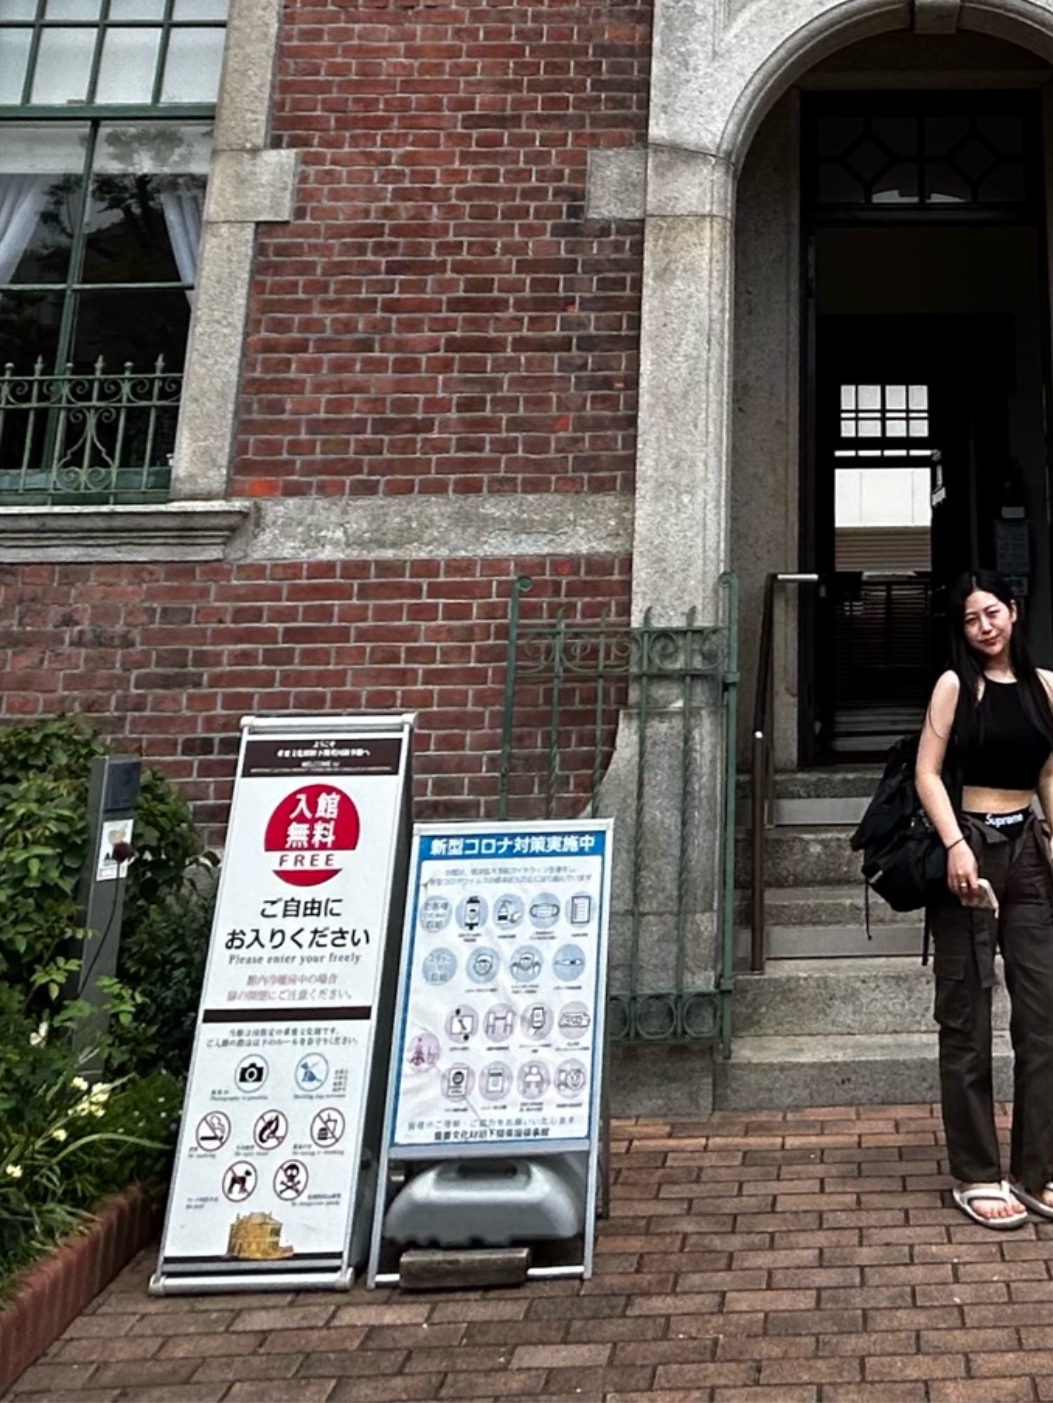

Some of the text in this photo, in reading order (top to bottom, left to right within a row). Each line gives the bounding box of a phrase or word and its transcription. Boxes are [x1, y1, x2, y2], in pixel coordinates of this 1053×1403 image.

[289, 792, 341, 819] 入館
[285, 820, 336, 849] 無料
[430, 834, 596, 856] 新型コロナ対策実施中
[278, 853, 336, 867] FREE
[260, 897, 343, 919] ご自由に
[224, 928, 370, 950] お入りください
[228, 952, 362, 966] Please enter your freely
